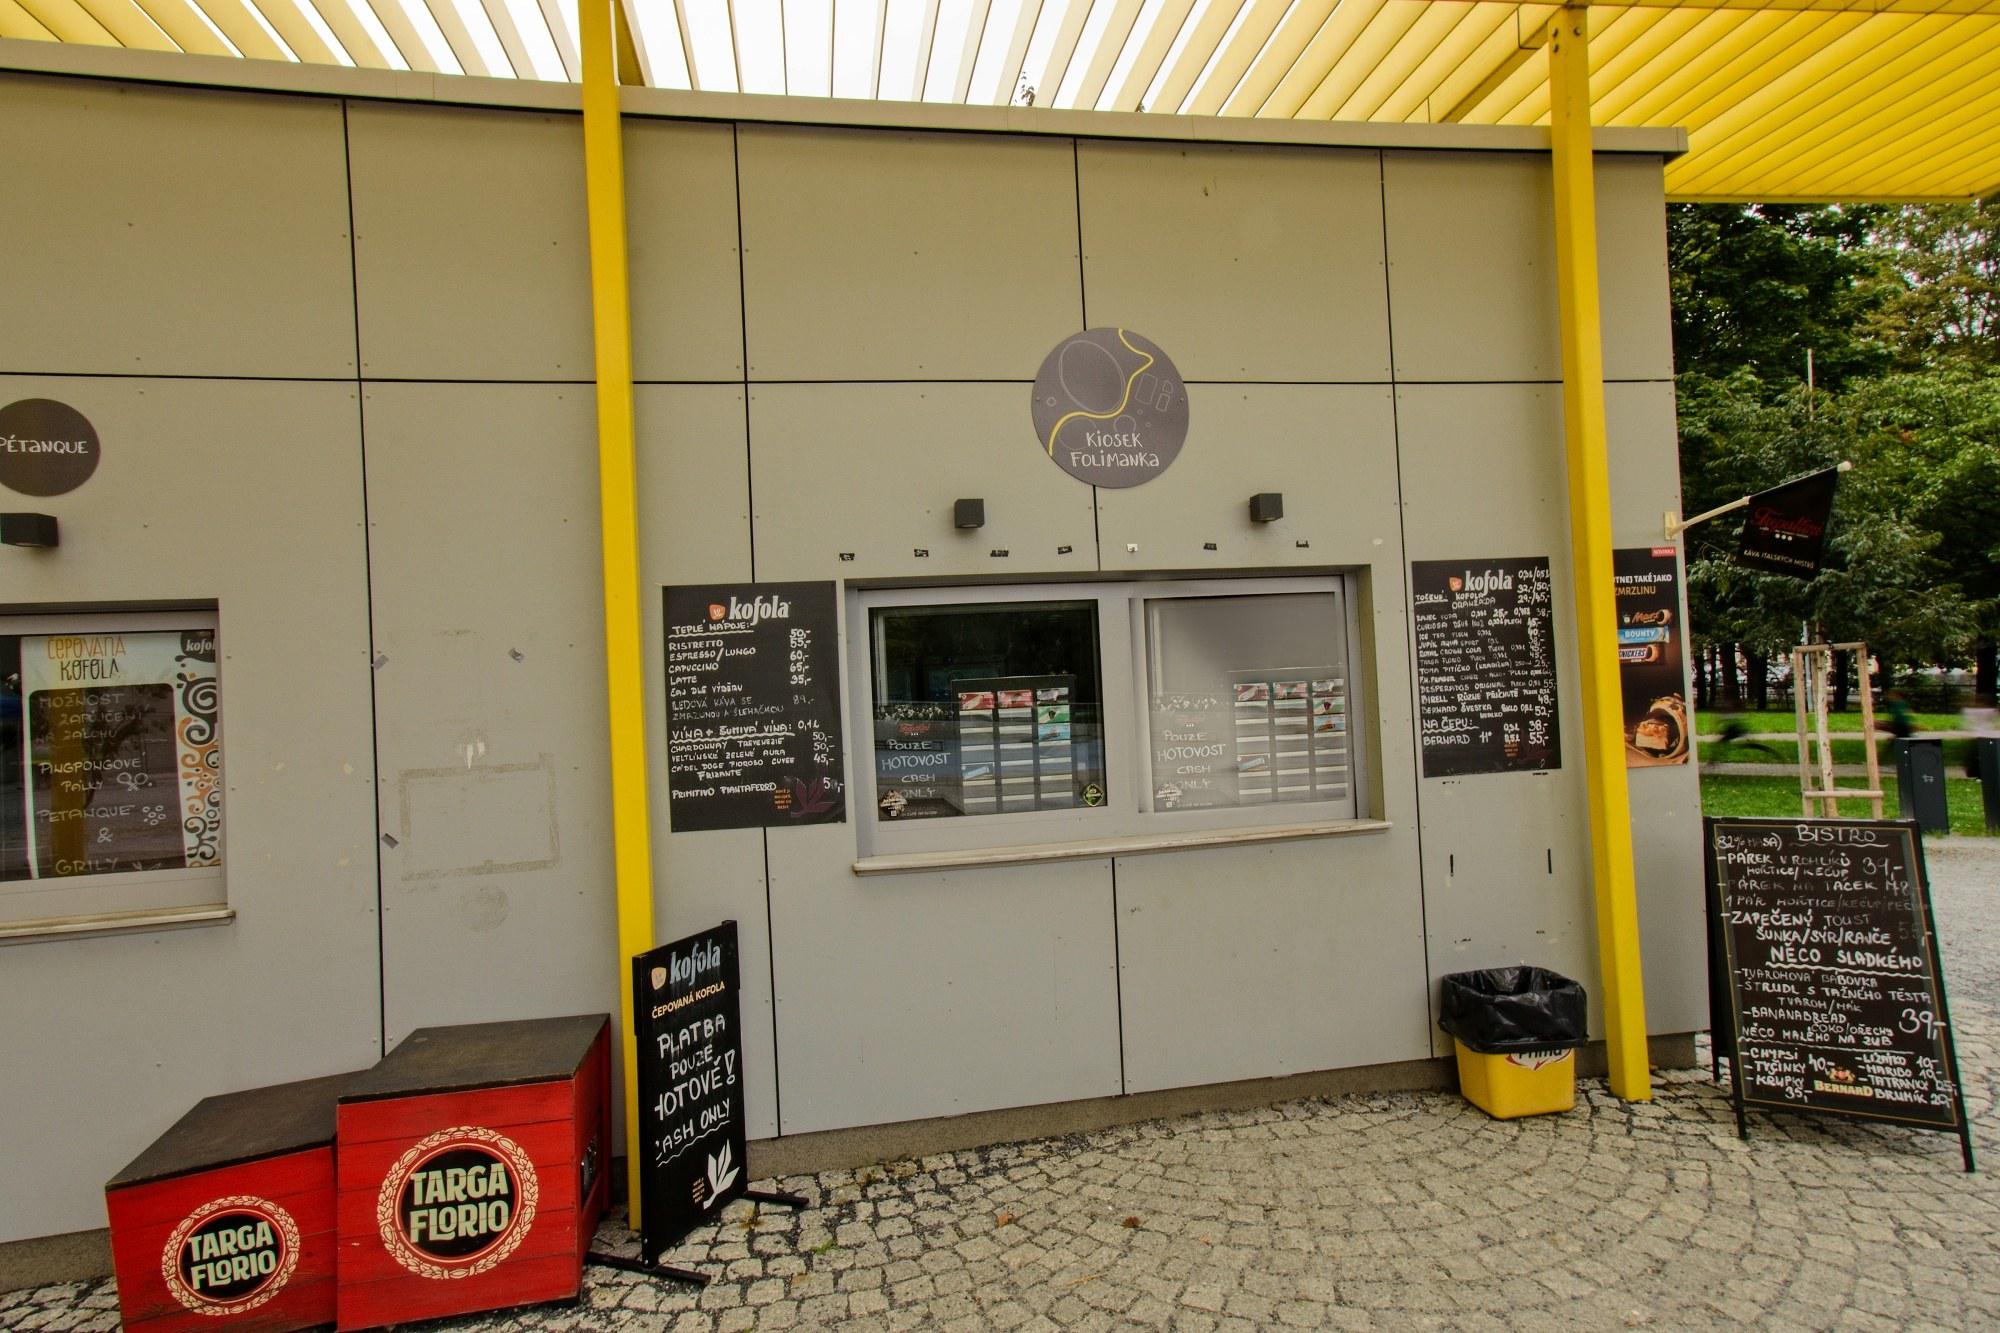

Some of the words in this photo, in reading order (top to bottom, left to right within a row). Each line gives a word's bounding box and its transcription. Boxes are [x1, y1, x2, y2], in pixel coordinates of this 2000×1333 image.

[1465, 570, 1512, 596] kofola
[1634, 572, 1652, 583] TAKÉ
[1652, 574, 1672, 583] JAKO
[729, 596, 790, 626] kofola
[669, 640, 724, 651] RISTRETTO
[668, 663, 719, 674] CAPUCCINO
[670, 676, 698, 684] LATTE
[1422, 718, 1438, 728] NA
[887, 738, 934, 751] POUZE
[1164, 730, 1208, 742] POUZE
[1423, 734, 1470, 746] BERNARD
[814, 753, 835, 766] 45,-
[882, 752, 952, 771] HOTOVOST
[1157, 744, 1226, 762] HOTOVOST
[1176, 765, 1211, 774] CASH
[902, 774, 936, 784] CASH
[97, 827, 114, 844] &
[1795, 824, 1876, 843] BISTRO
[670, 938, 721, 986] kofola
[1770, 942, 1821, 964] NĚCO
[1837, 946, 1923, 970] SLADKÉHO
[652, 991, 694, 1019] ČEPOVANÁ
[696, 980, 725, 1001] KOFOLA
[656, 1014, 726, 1059] PLATBA
[1838, 1034, 1856, 1044] NA
[1862, 1034, 1893, 1046] ZUB
[670, 1044, 713, 1080] POUZE
[1814, 1080, 1874, 1098] BERNARD
[700, 1098, 730, 1130] ONLY
[410, 1162, 508, 1206] TARGA
[410, 1198, 510, 1244] FLORIO
[188, 1220, 274, 1263] TARGA
[190, 1249, 277, 1291] FLORIO
